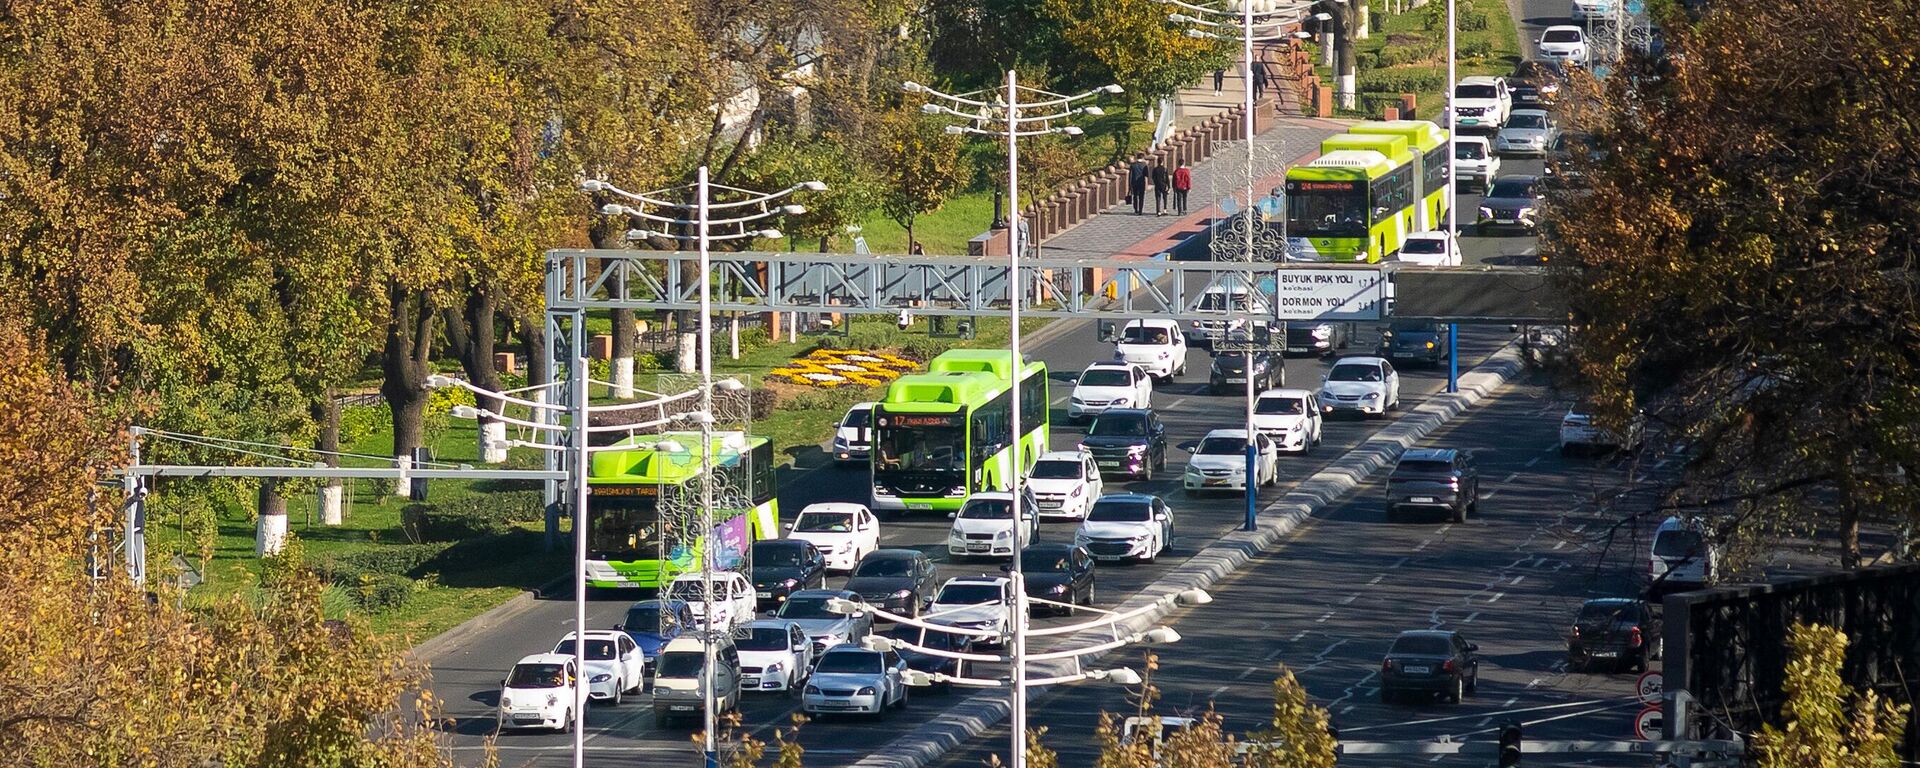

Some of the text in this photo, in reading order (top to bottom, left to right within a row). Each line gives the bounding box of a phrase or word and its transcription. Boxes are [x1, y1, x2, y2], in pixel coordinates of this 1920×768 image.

[1282, 274, 1312, 283] BUYUK
[1314, 274, 1333, 283] IPAK
[895, 415, 906, 426] 17
